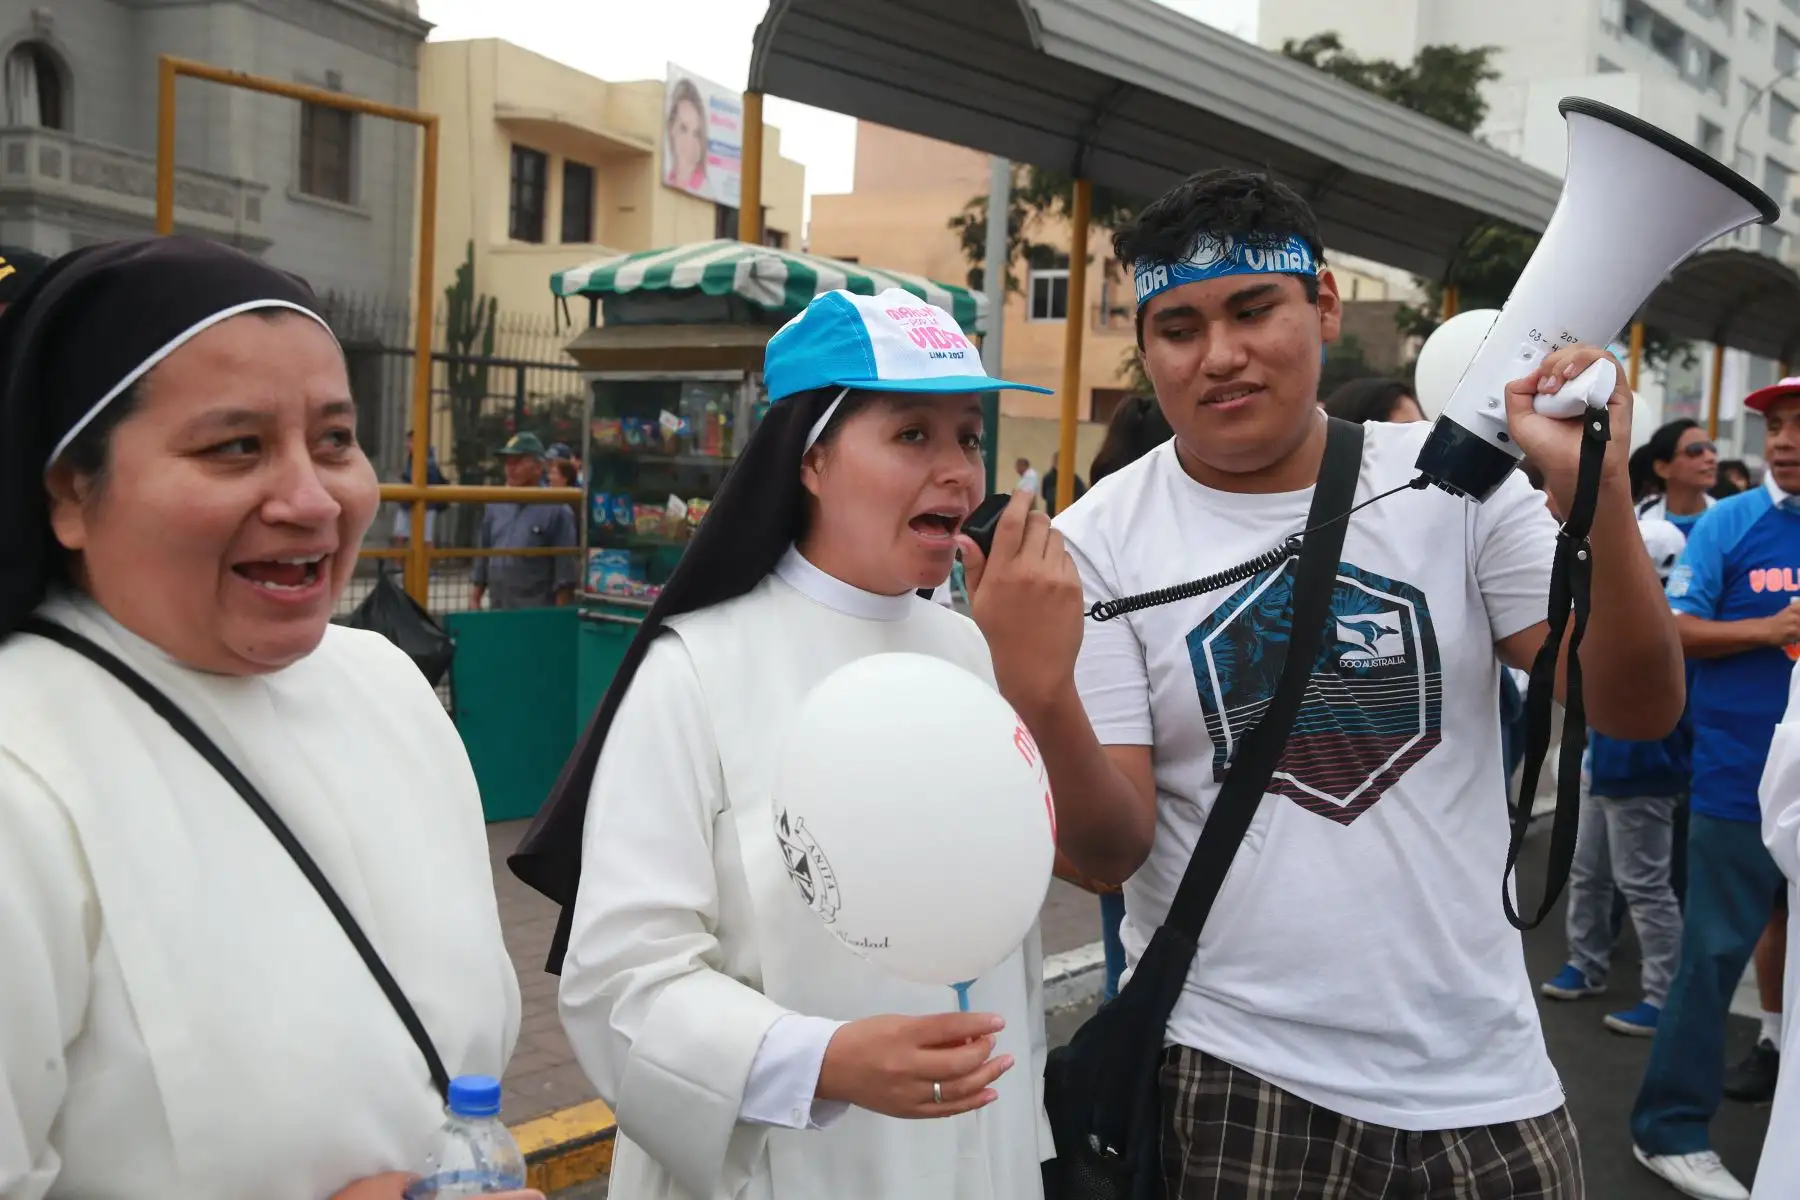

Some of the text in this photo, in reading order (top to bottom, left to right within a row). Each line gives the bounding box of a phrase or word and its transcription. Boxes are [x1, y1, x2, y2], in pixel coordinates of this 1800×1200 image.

[906, 326, 968, 350] VIDA
[929, 351, 964, 359] LIMA 2017
[1749, 567, 1800, 594] VOL
[1362, 656, 1406, 668] AUSTRALIA
